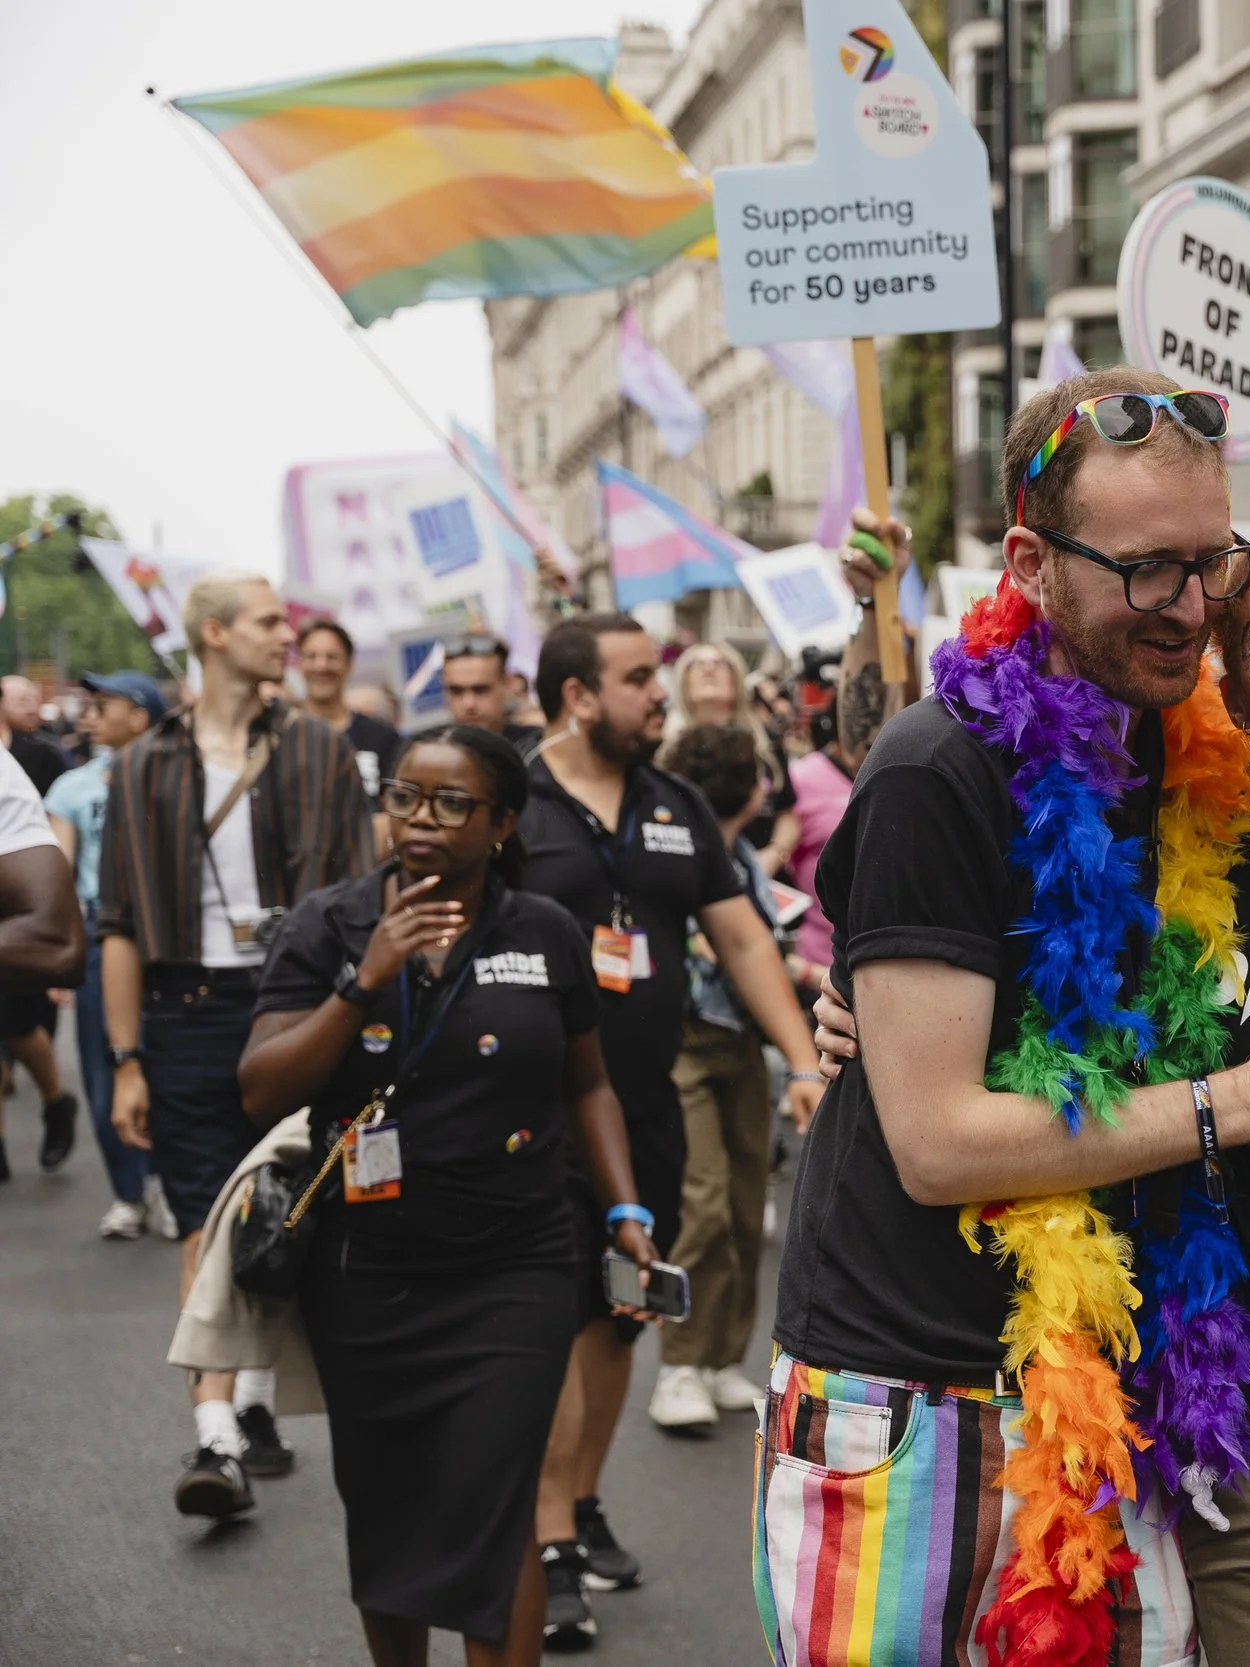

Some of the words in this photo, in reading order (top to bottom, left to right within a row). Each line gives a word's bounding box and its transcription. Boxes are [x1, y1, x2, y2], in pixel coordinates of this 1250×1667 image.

[741, 197, 915, 235] Supporting
[745, 246, 797, 269] our
[805, 230, 969, 261] community
[749, 279, 796, 305] for
[806, 274, 844, 301] 50
[854, 273, 937, 305] years
[1205, 299, 1241, 338] OF
[473, 950, 548, 975] PRIDE
